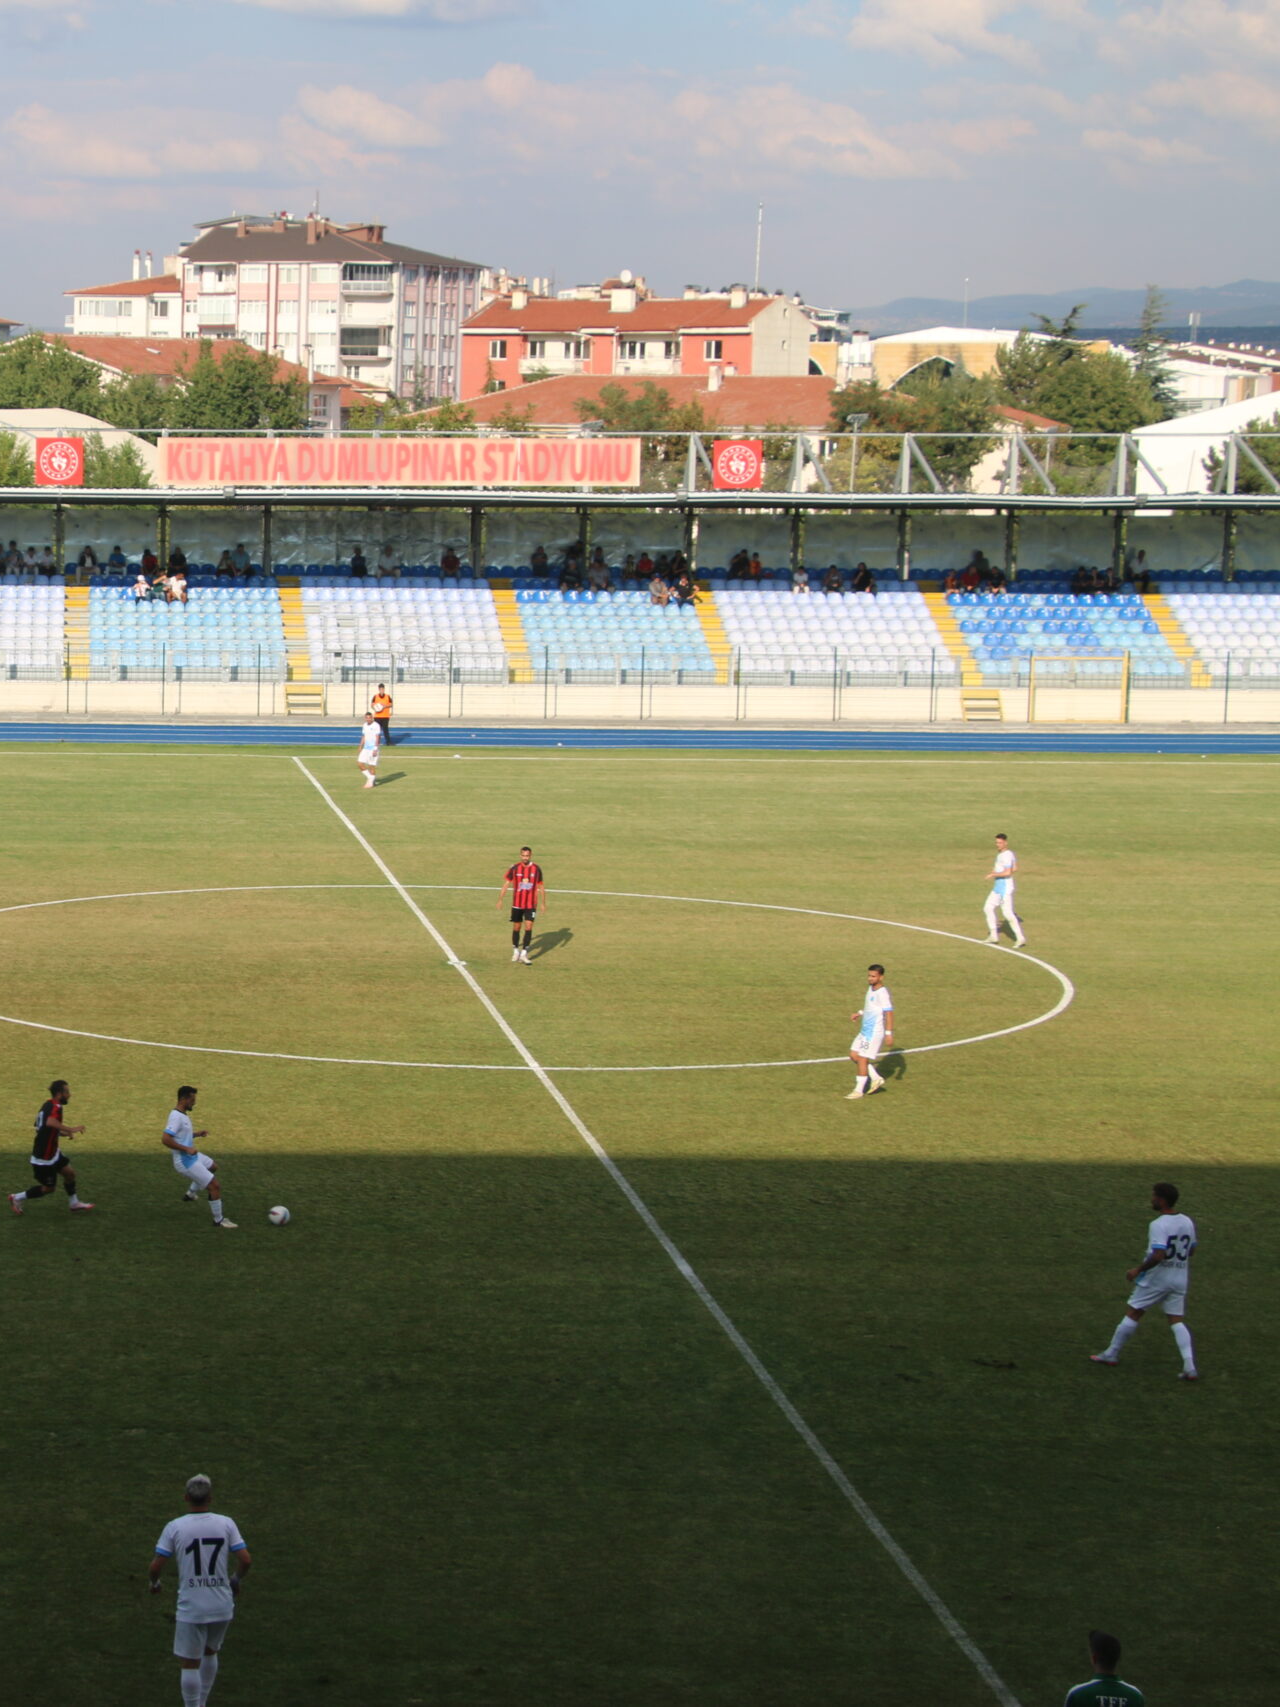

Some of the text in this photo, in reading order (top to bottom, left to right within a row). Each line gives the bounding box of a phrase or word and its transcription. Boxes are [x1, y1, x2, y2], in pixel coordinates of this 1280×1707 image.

[167, 443, 633, 482] KÜTAHYA DUMLUPINAR STADYUMU
[1165, 1234, 1191, 1261] 53
[185, 1538, 225, 1576] 17
